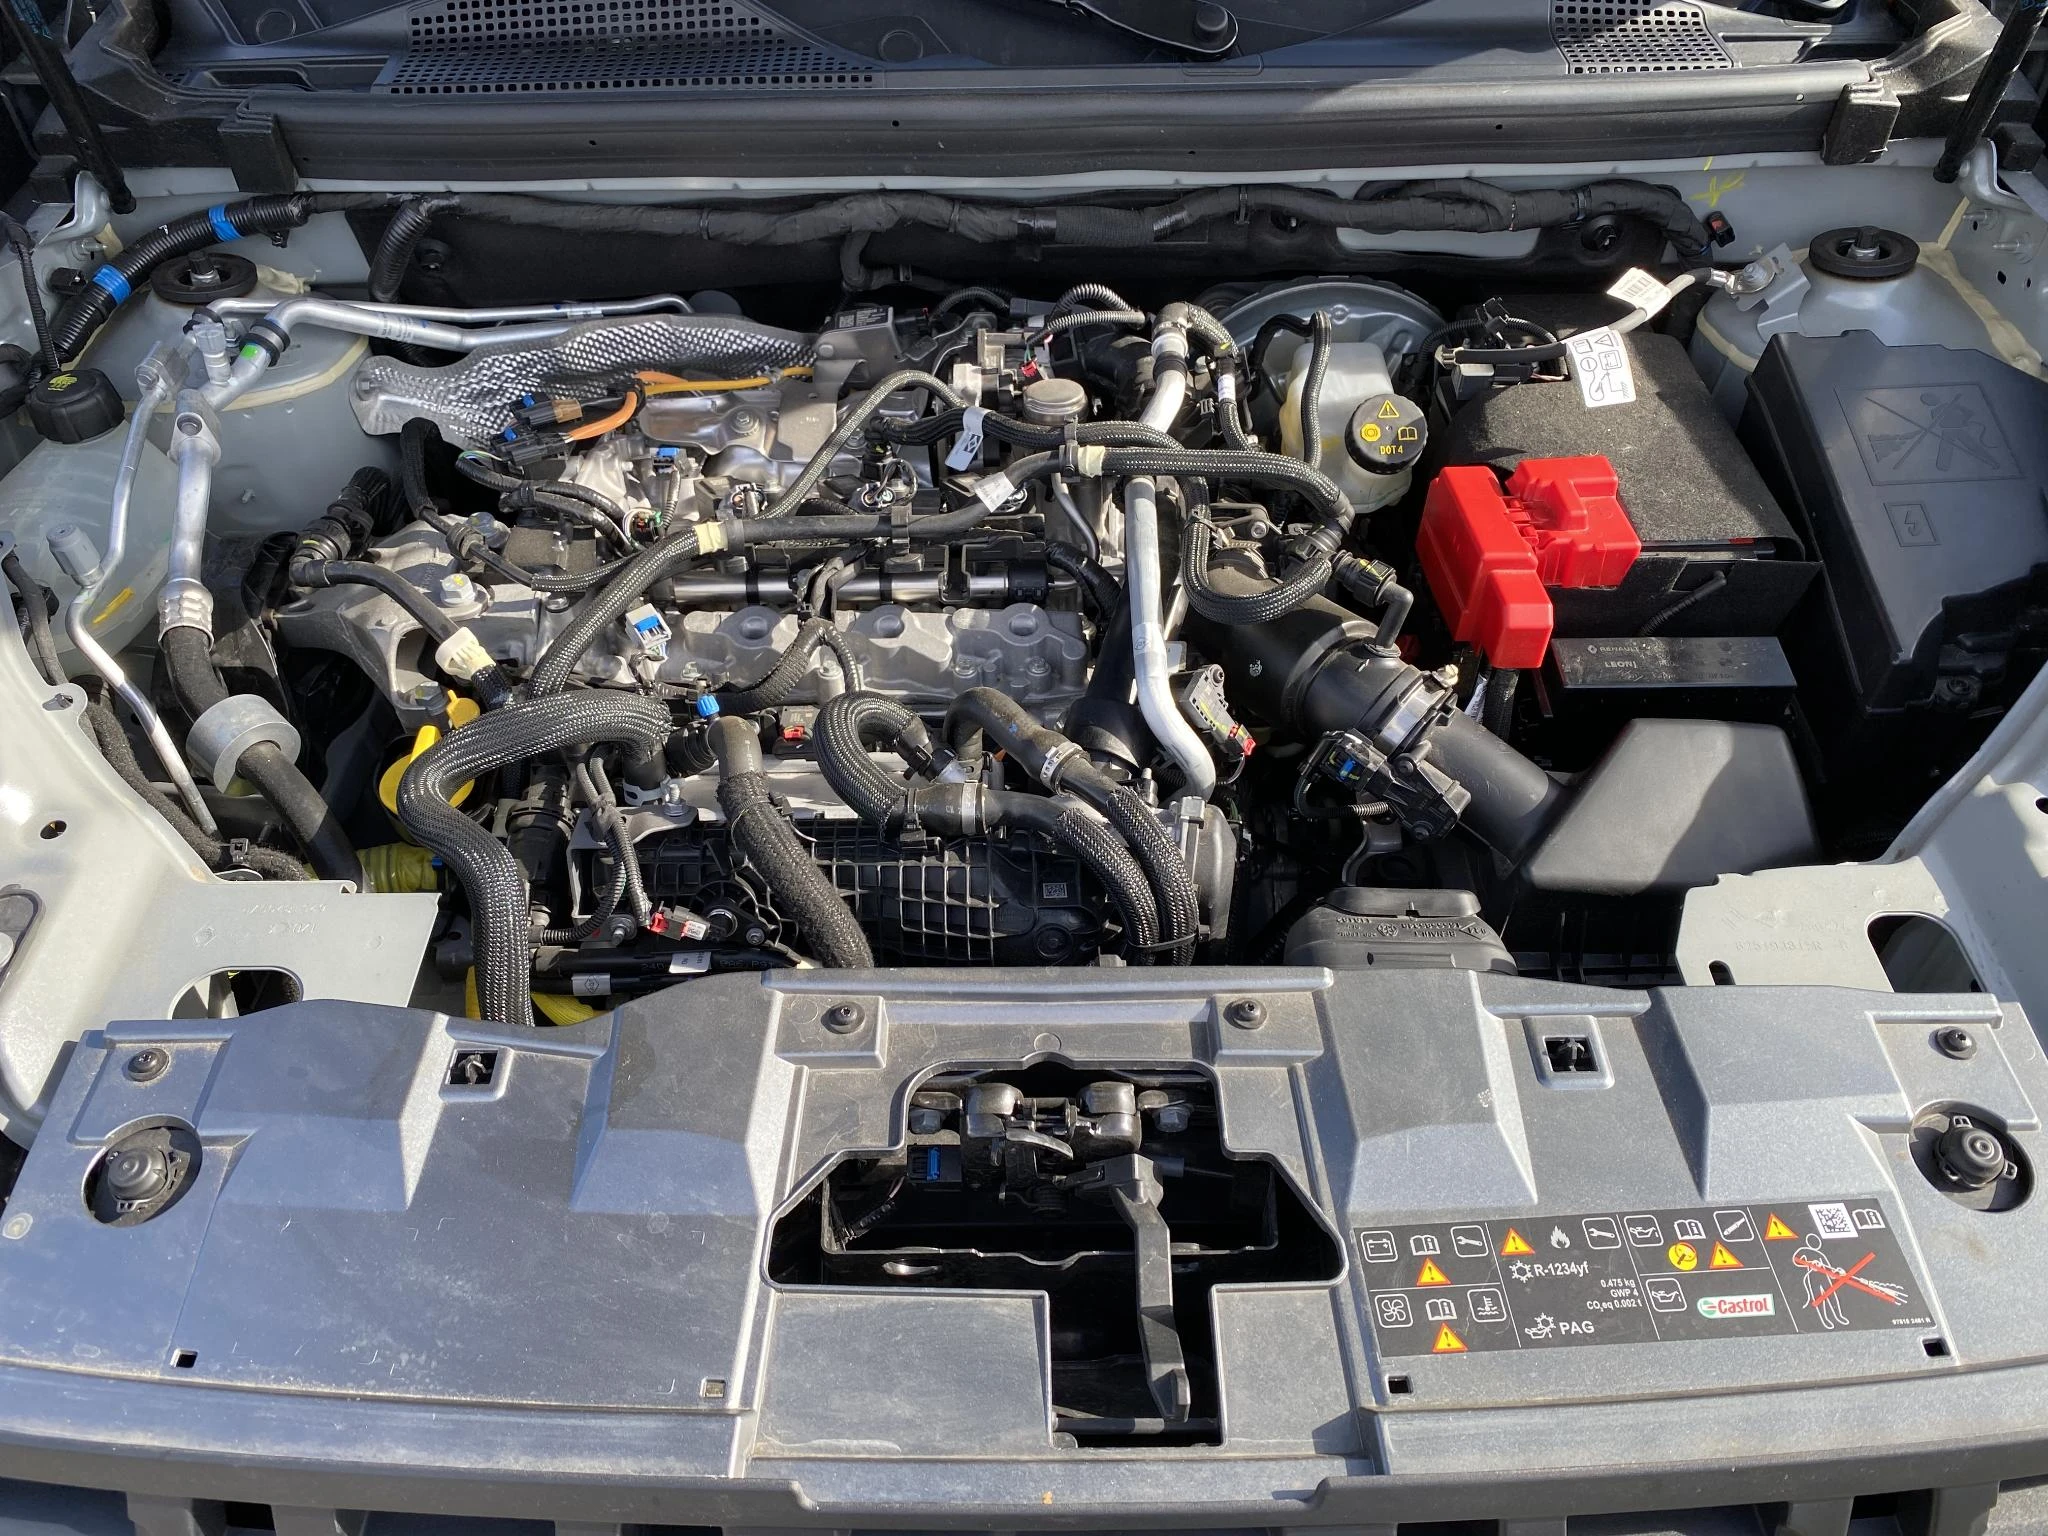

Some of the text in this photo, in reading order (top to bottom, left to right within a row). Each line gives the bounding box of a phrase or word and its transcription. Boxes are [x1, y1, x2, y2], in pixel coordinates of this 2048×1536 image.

[1380, 445, 1403, 454] DOT 4
[1533, 1261, 1590, 1277] R-1234yf
[1600, 1278, 1636, 1288] 0.475 kg
[1610, 1288, 1639, 1298] GWP 4
[1615, 1298, 1637, 1309] 0.002
[1717, 1297, 1771, 1314] Castrol
[1559, 1320, 1595, 1335] PAG
